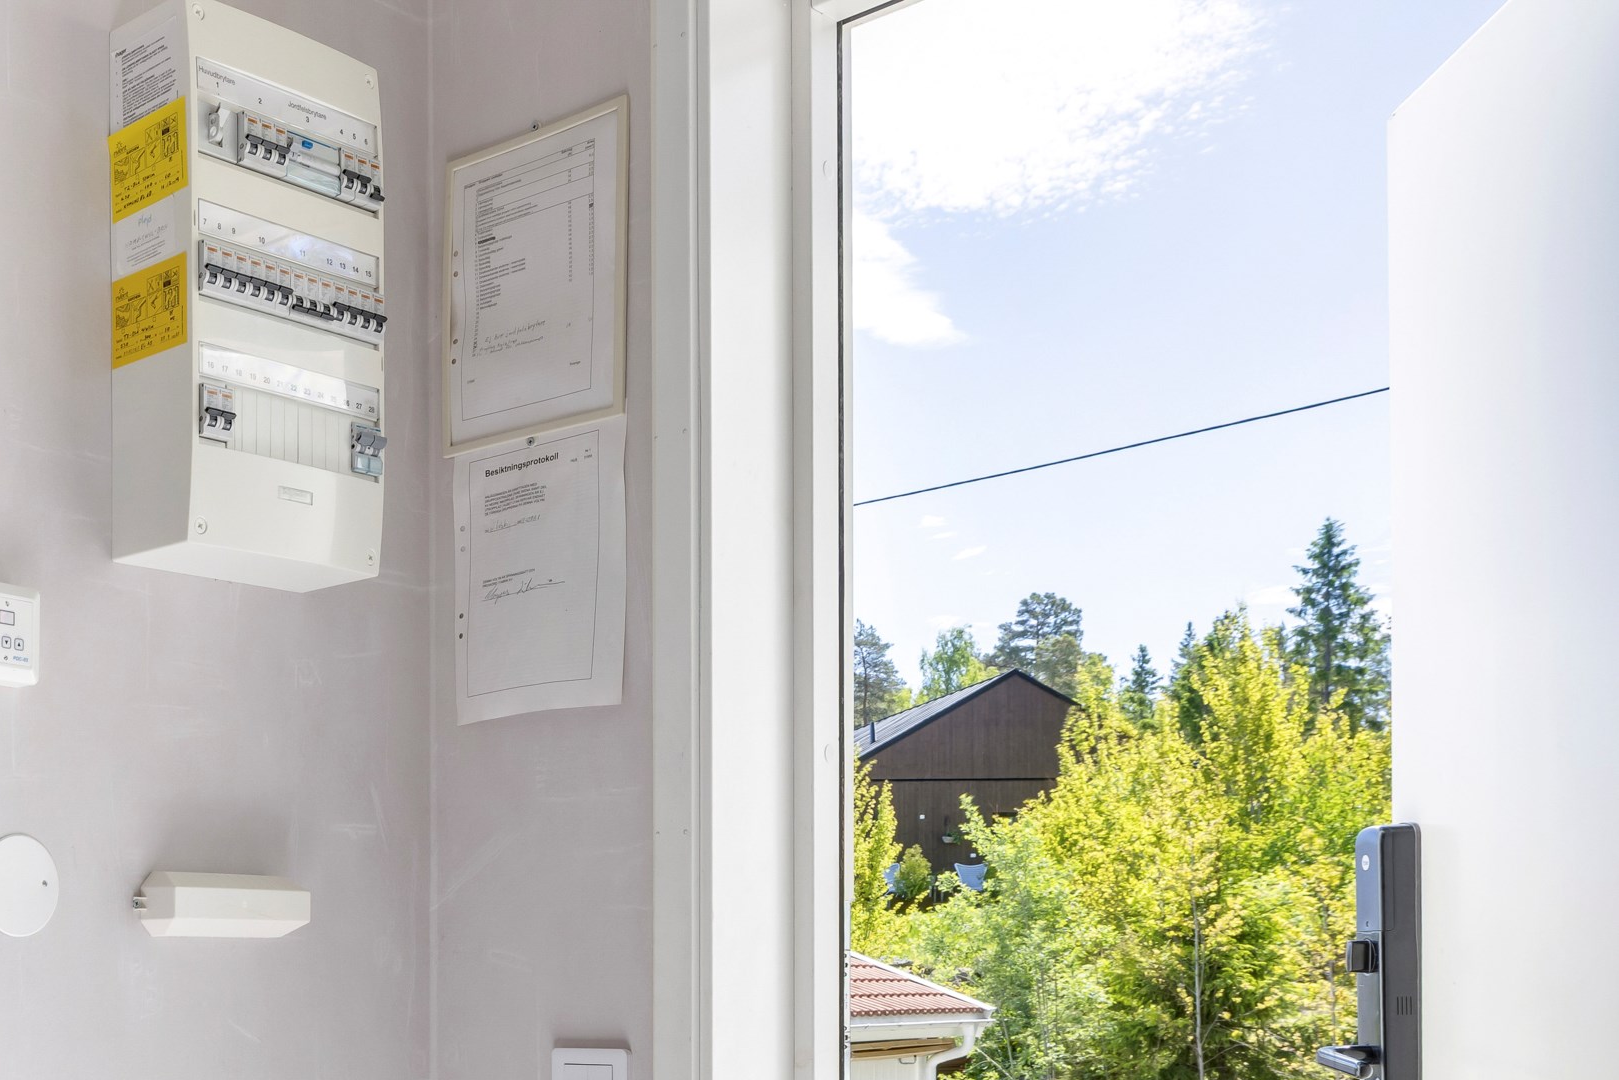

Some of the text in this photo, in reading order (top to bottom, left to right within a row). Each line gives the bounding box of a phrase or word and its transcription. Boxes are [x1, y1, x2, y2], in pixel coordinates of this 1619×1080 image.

[198, 65, 236, 86] Huvudbrytare
[258, 236, 266, 244] 10
[326, 258, 333, 266] 12
[339, 262, 346, 270] 13
[365, 270, 372, 278] 15
[221, 365, 228, 373] 17
[263, 376, 270, 384] 20
[485, 452, 559, 478] Besiktningsprotokoll
